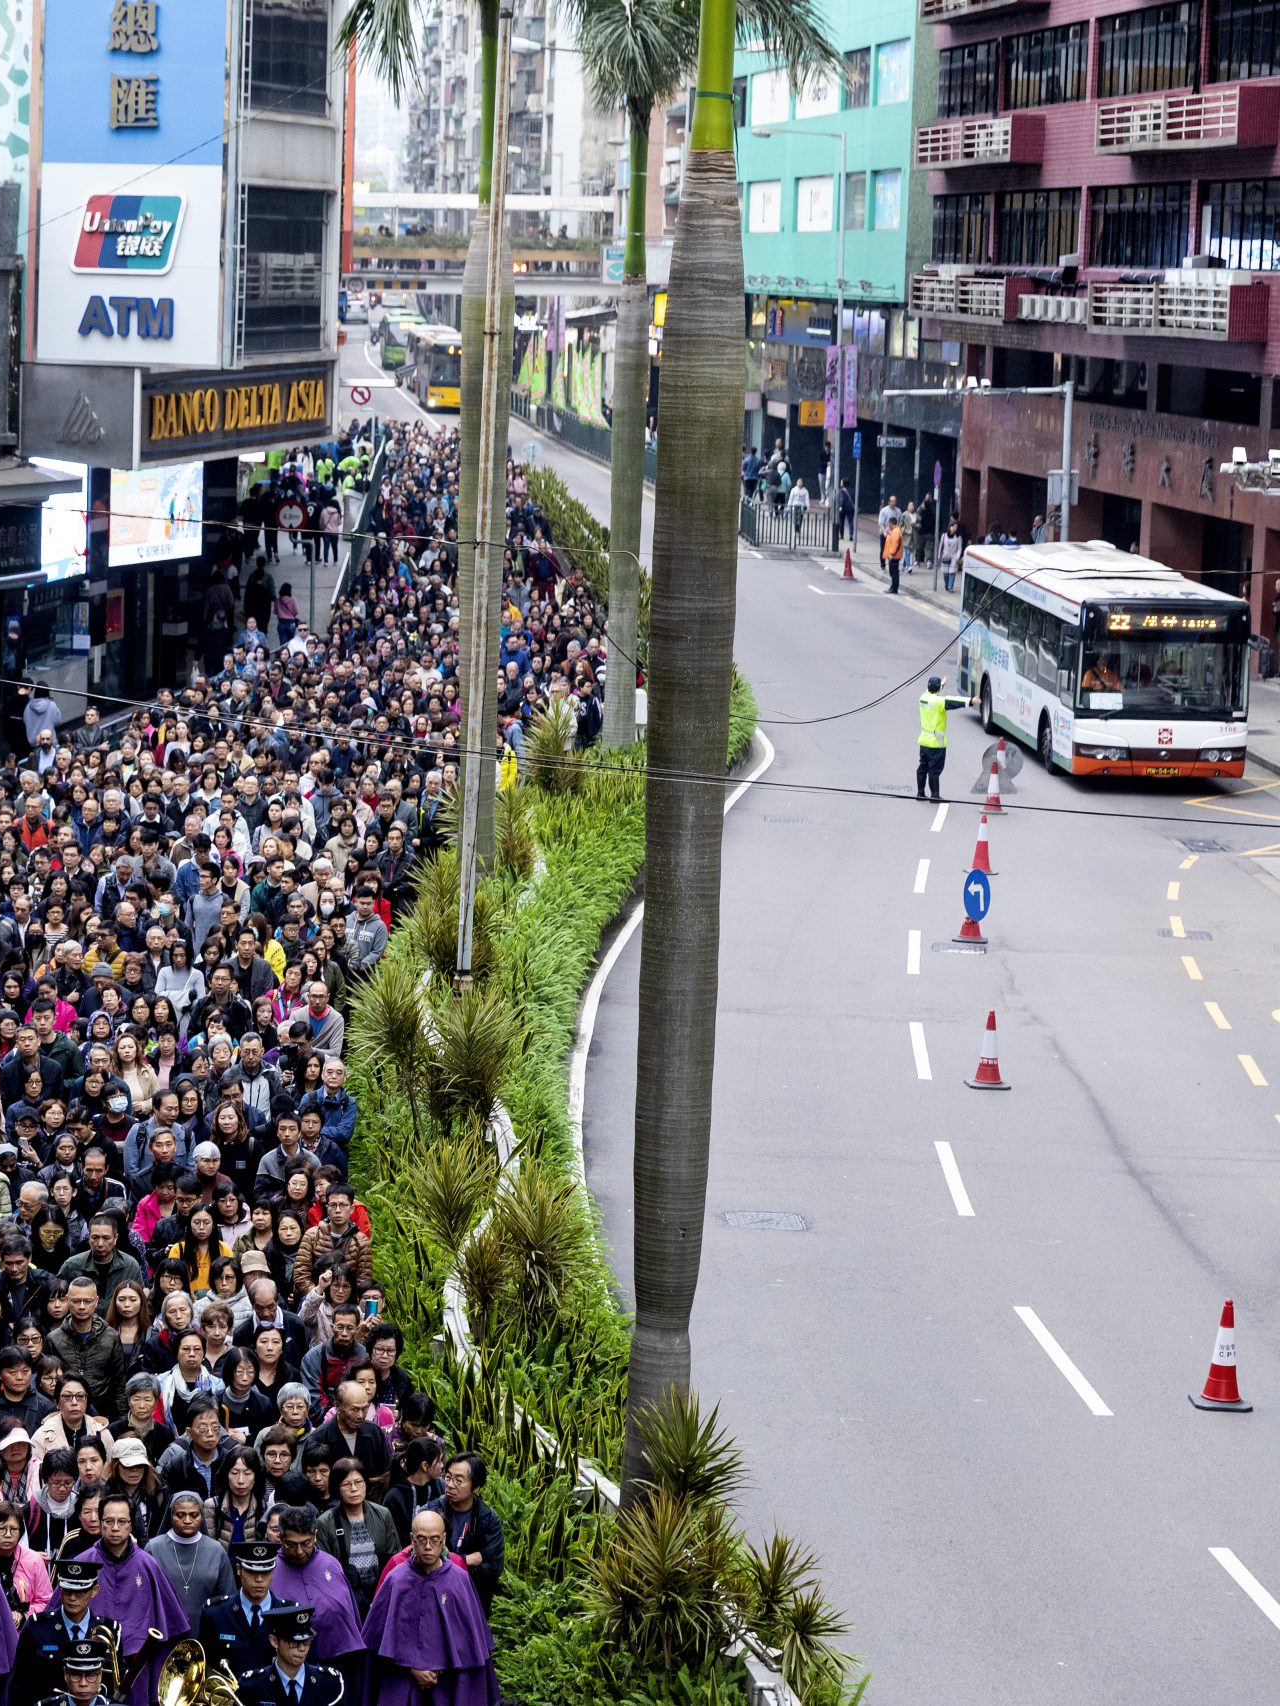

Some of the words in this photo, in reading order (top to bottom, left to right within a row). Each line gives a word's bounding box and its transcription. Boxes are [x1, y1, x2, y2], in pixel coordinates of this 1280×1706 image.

[83, 211, 173, 241] UnionPay
[116, 235, 164, 257] 银联
[78, 295, 174, 339] ATM
[150, 388, 220, 441] BANCO
[223, 383, 283, 431] DELTA
[286, 379, 325, 423] ASIA
[1109, 614, 1131, 630] 22
